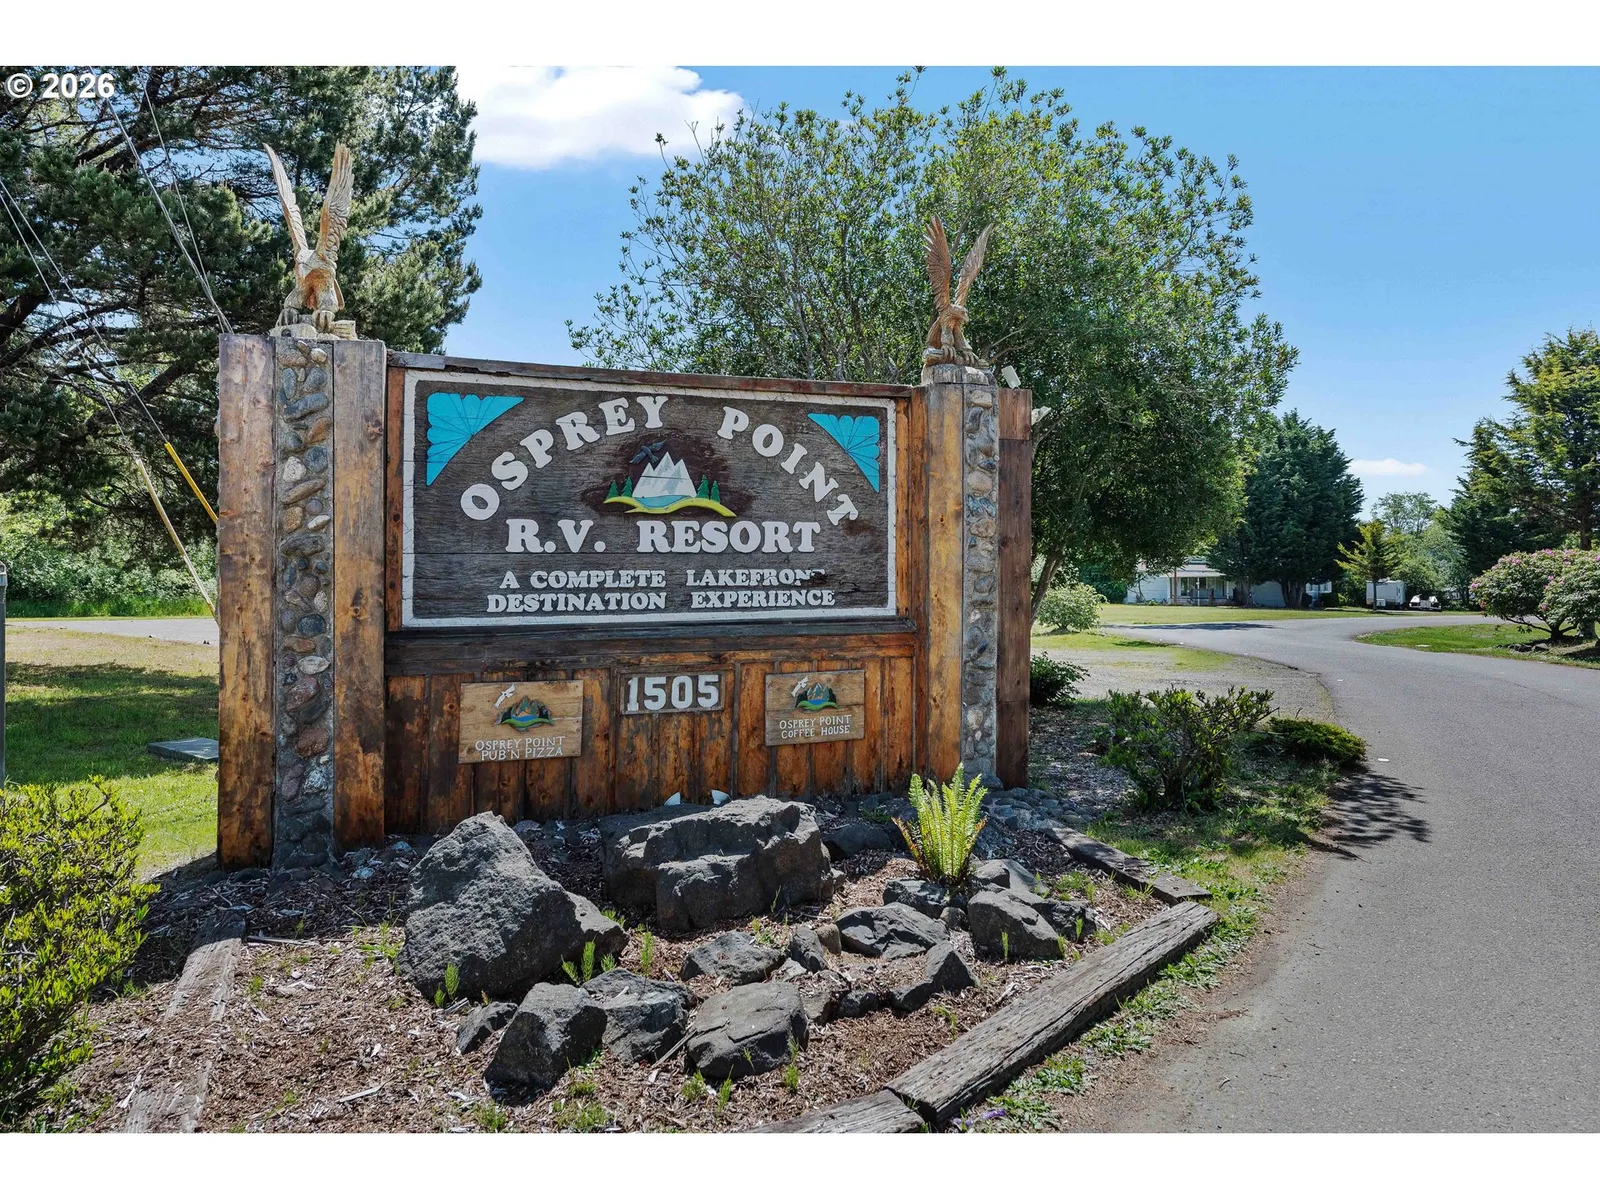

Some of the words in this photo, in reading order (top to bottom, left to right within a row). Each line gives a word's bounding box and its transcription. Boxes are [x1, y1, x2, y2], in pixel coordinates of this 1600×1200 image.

[460, 396, 668, 520] OSPREY
[717, 406, 858, 525] POINT
[506, 519, 606, 553] R.V.
[637, 521, 821, 553] RESORT
[499, 571, 520, 589] A
[530, 570, 667, 589] COMPLETE
[487, 592, 667, 612] DESTINATION
[691, 590, 835, 609] EXPERIENCE
[627, 674, 719, 712] 1505
[779, 718, 817, 730] OSPREY
[819, 714, 852, 726] POINT
[781, 728, 815, 739] COFFEE
[821, 725, 850, 736] HOUSE
[475, 739, 522, 752] OSPREY
[525, 735, 566, 748] POINT
[525, 747, 563, 758] PIZZA
